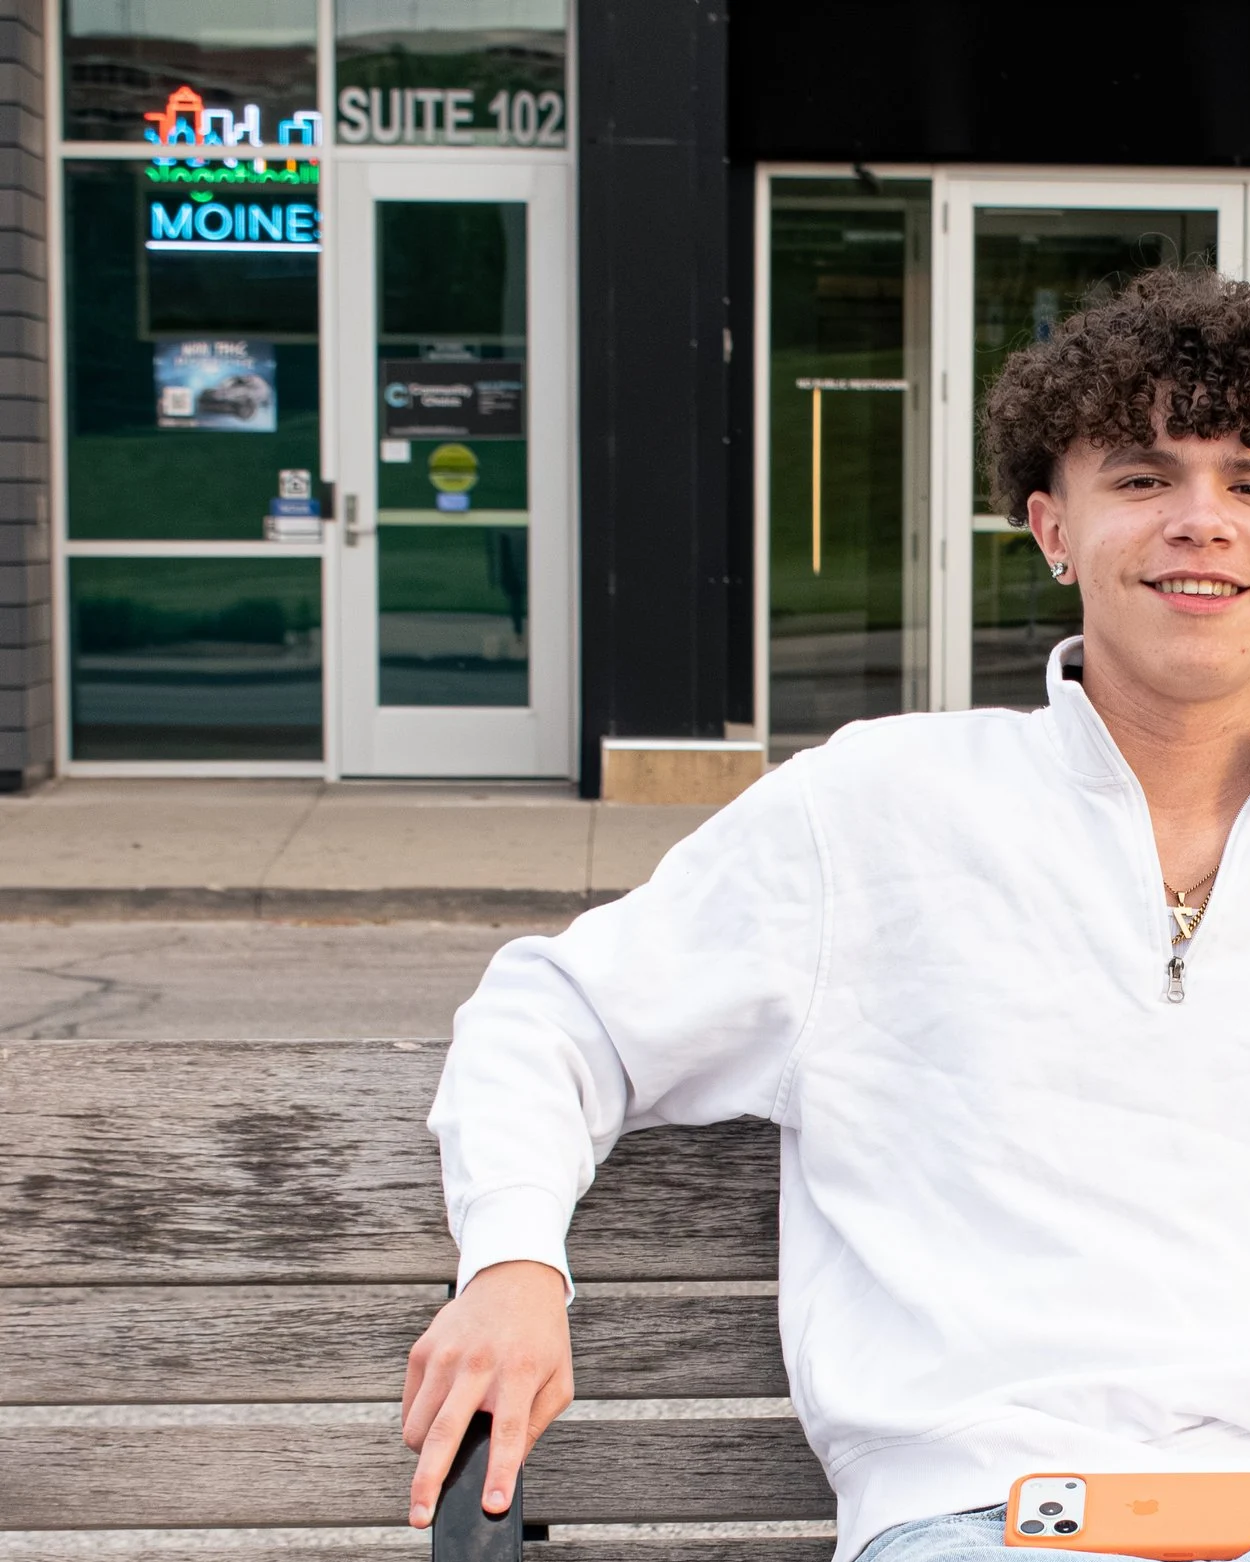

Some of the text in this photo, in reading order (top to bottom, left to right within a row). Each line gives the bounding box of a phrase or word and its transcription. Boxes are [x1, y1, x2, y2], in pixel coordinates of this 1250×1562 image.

[338, 86, 474, 144] SUITE
[488, 90, 566, 146] 102
[151, 203, 324, 242] MOINE
